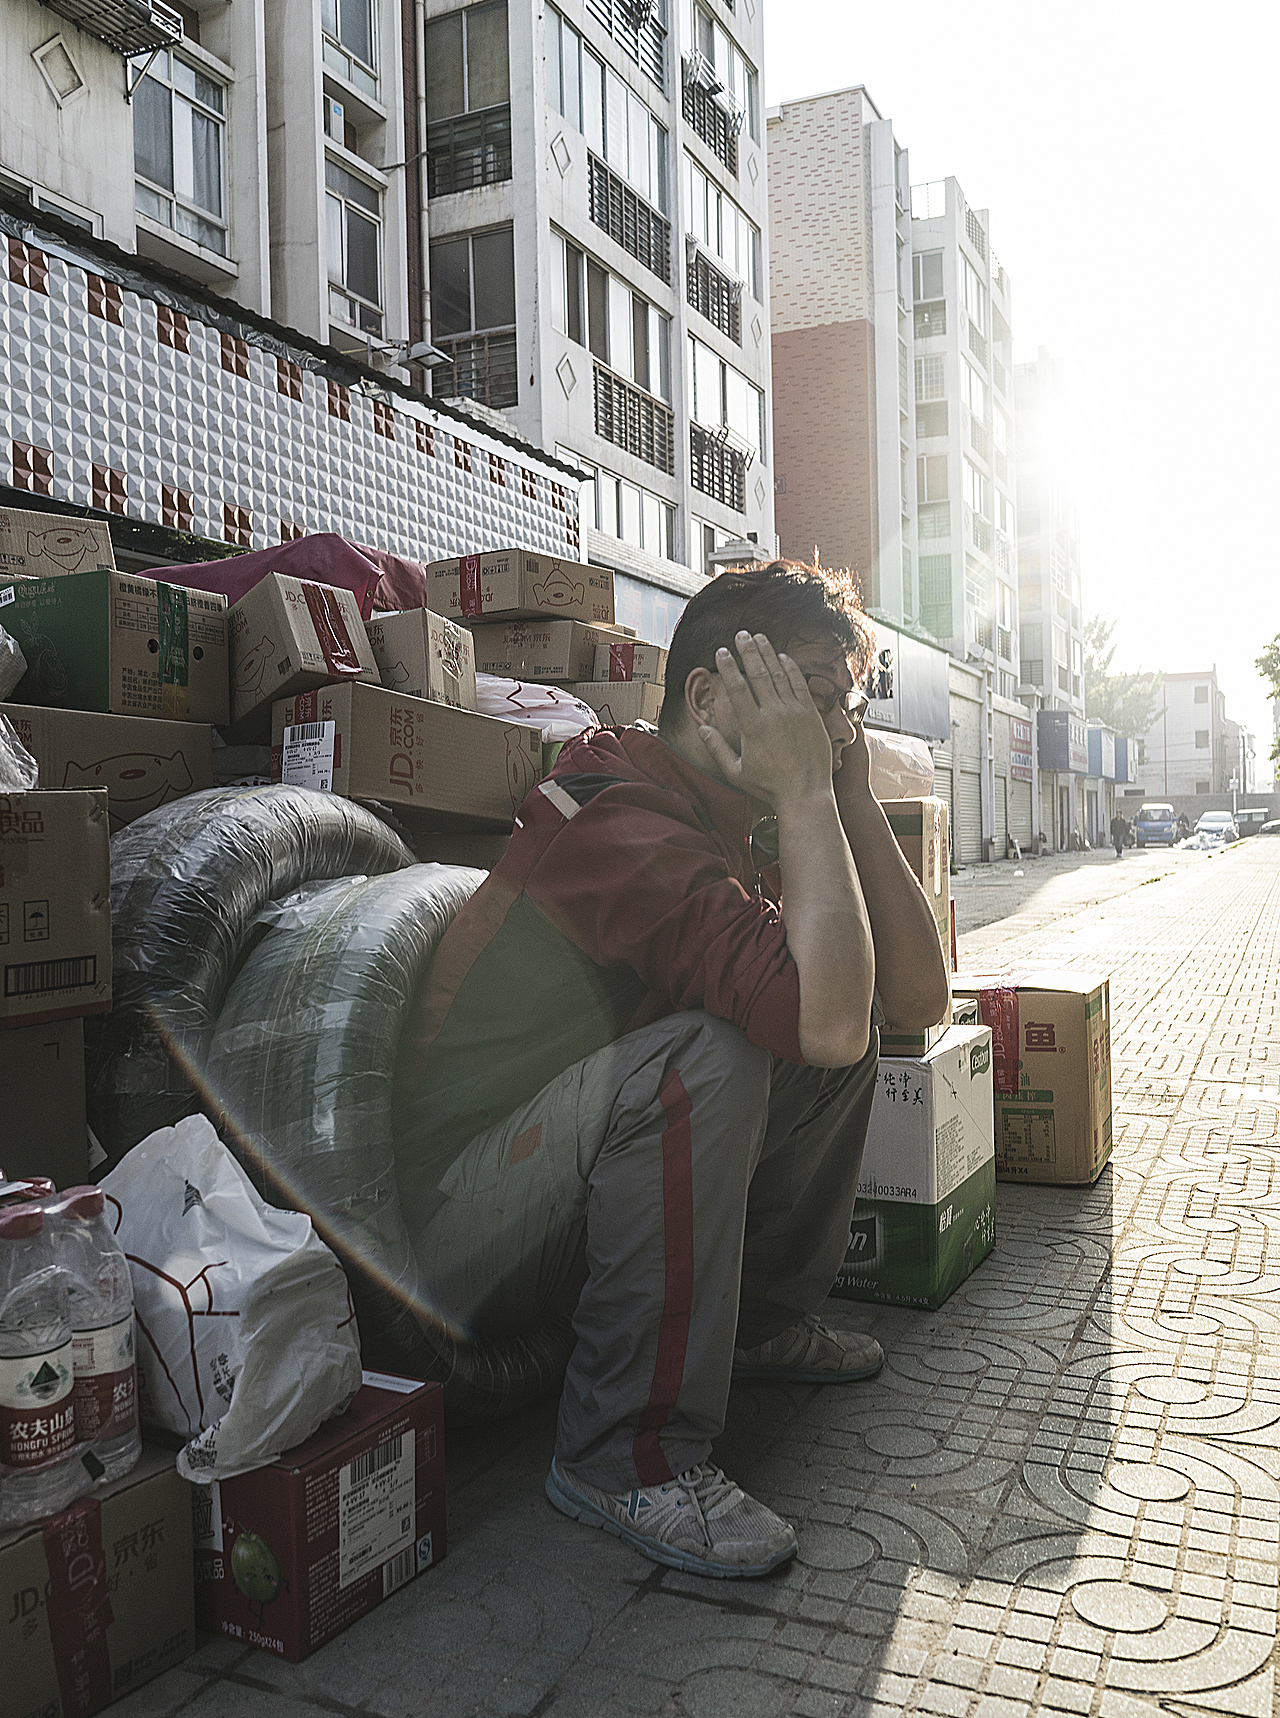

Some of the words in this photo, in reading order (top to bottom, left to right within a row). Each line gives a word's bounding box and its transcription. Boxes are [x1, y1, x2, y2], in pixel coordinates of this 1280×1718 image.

[389, 706, 403, 747] 京东
[971, 1049, 989, 1071] Cestbon
[885, 1087, 923, 1105] 行至美
[847, 1276, 879, 1290] Water
[11, 1437, 49, 1452] NONGFU
[113, 1517, 166, 1567] 京东
